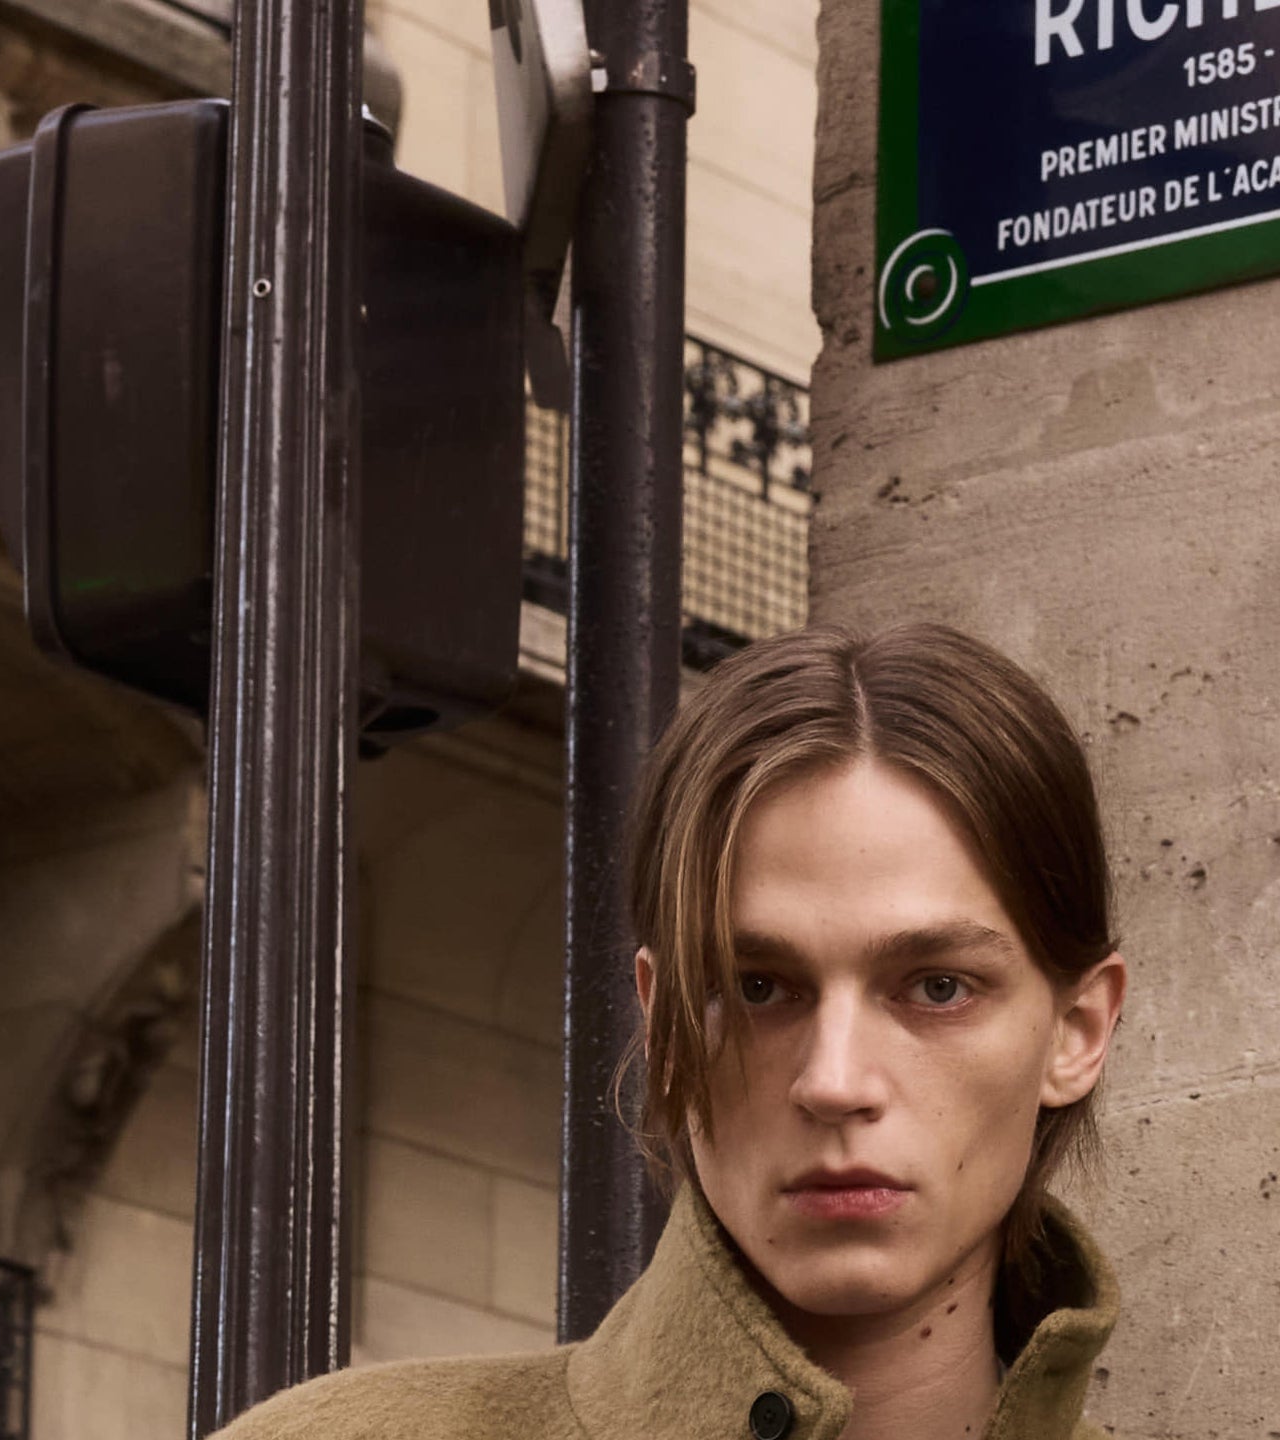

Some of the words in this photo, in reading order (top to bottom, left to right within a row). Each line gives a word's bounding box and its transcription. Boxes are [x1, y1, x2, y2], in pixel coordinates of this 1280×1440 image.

[1183, 42, 1257, 88] 1585
[1041, 124, 1167, 182] PREMIER
[998, 186, 1157, 251] FONDATEUR
[1164, 174, 1200, 212] DE
